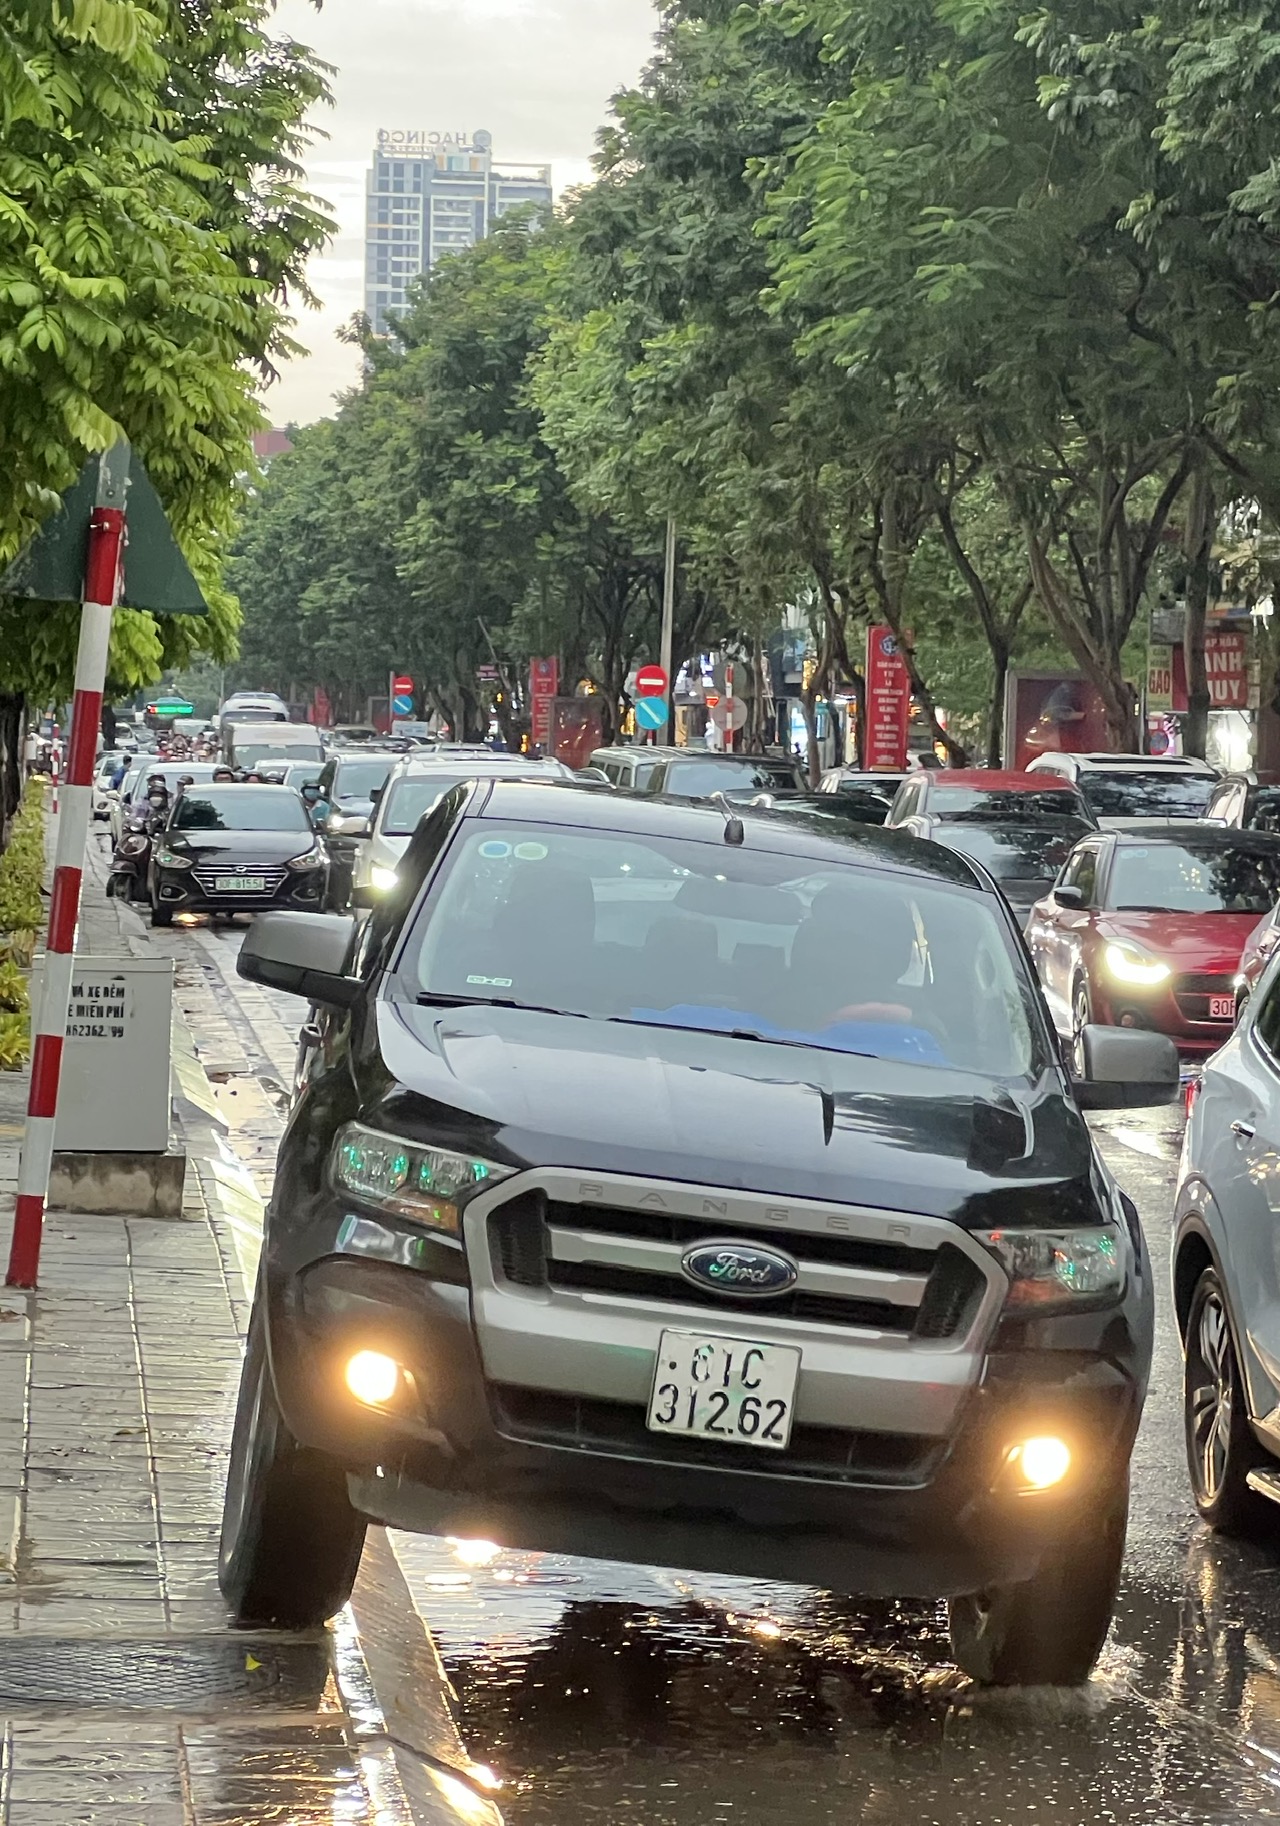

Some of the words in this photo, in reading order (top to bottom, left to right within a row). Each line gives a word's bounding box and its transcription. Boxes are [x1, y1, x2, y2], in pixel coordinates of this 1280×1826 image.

[88, 986, 100, 998] XE
[578, 1182, 912, 1238] RANGER
[708, 1252, 771, 1283] Ford
[691, 1343, 765, 1390] 61C
